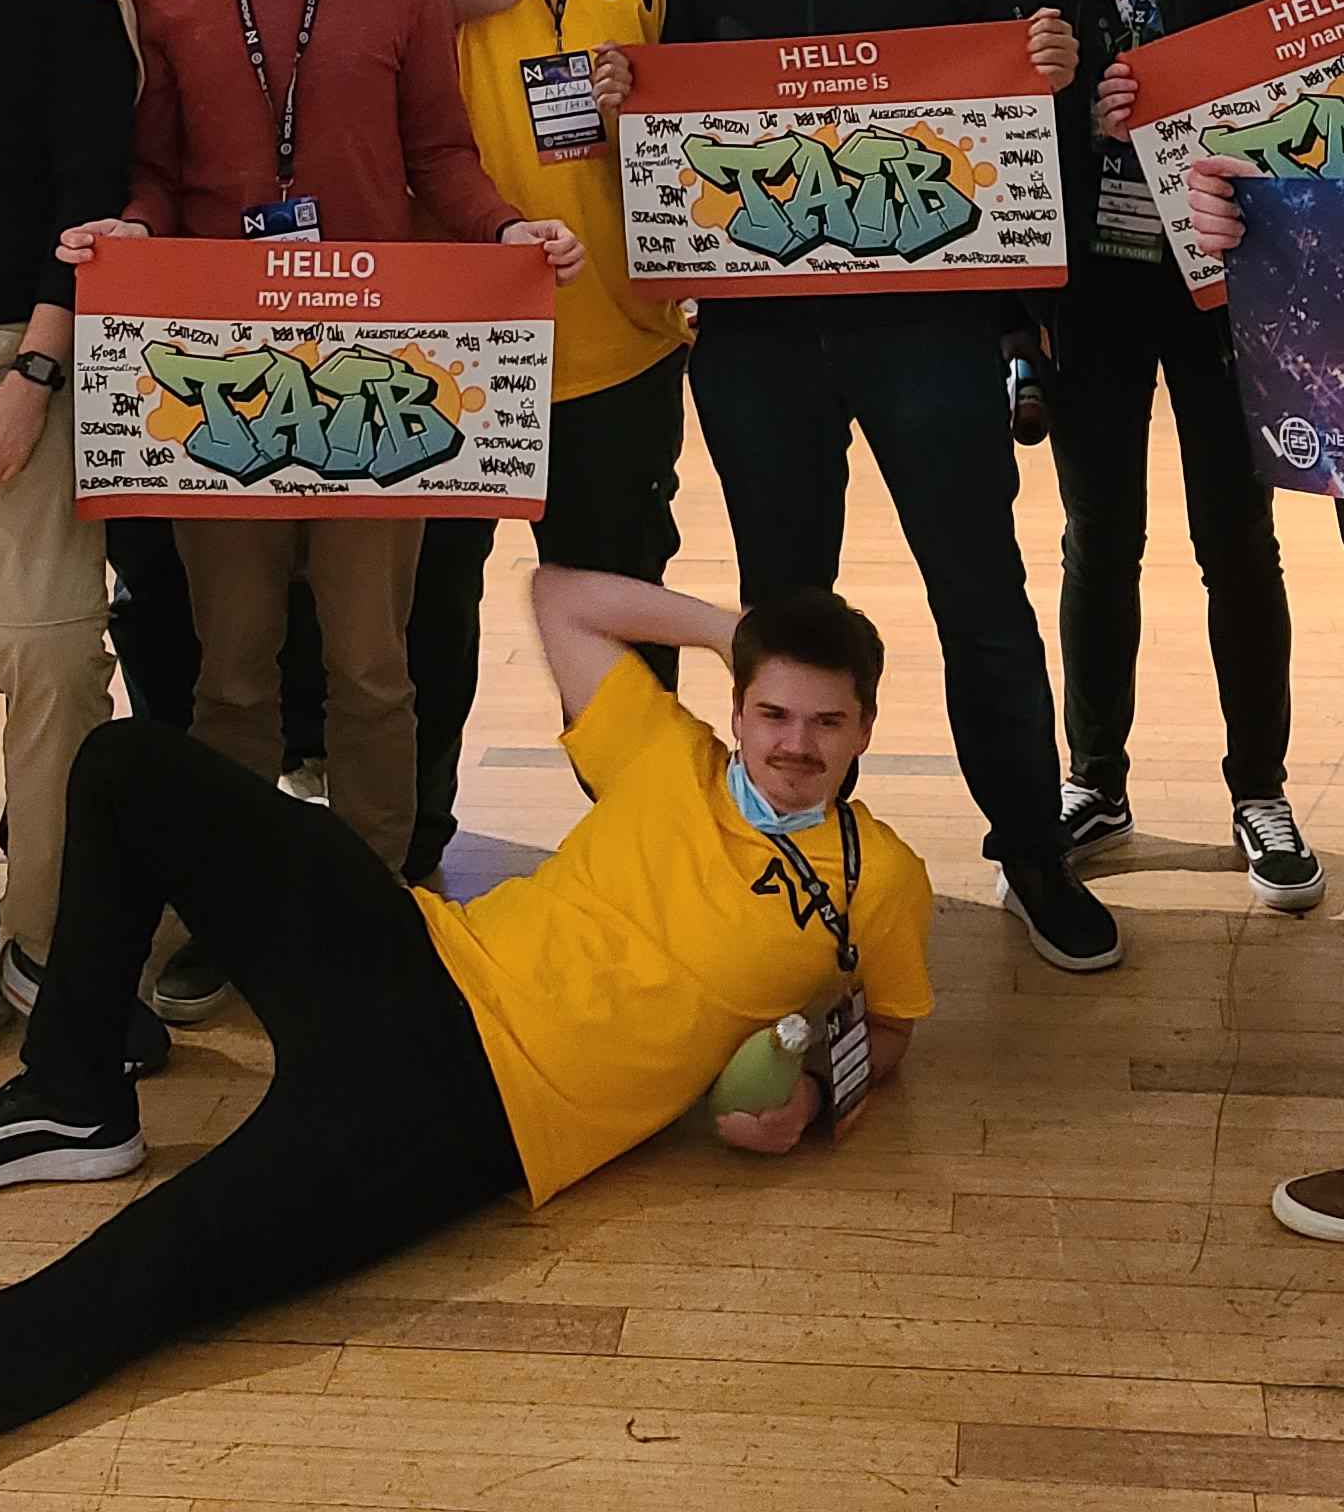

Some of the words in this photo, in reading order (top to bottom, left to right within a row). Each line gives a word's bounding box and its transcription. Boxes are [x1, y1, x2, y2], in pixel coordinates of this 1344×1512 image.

[779, 41, 878, 71] HELLO
[1275, 39, 1306, 59] my
[777, 79, 807, 99] my
[812, 75, 868, 94] name
[872, 72, 889, 91] is
[266, 251, 375, 278] HELLO
[258, 290, 289, 311] my
[297, 290, 358, 307] name
[363, 287, 381, 307] is
